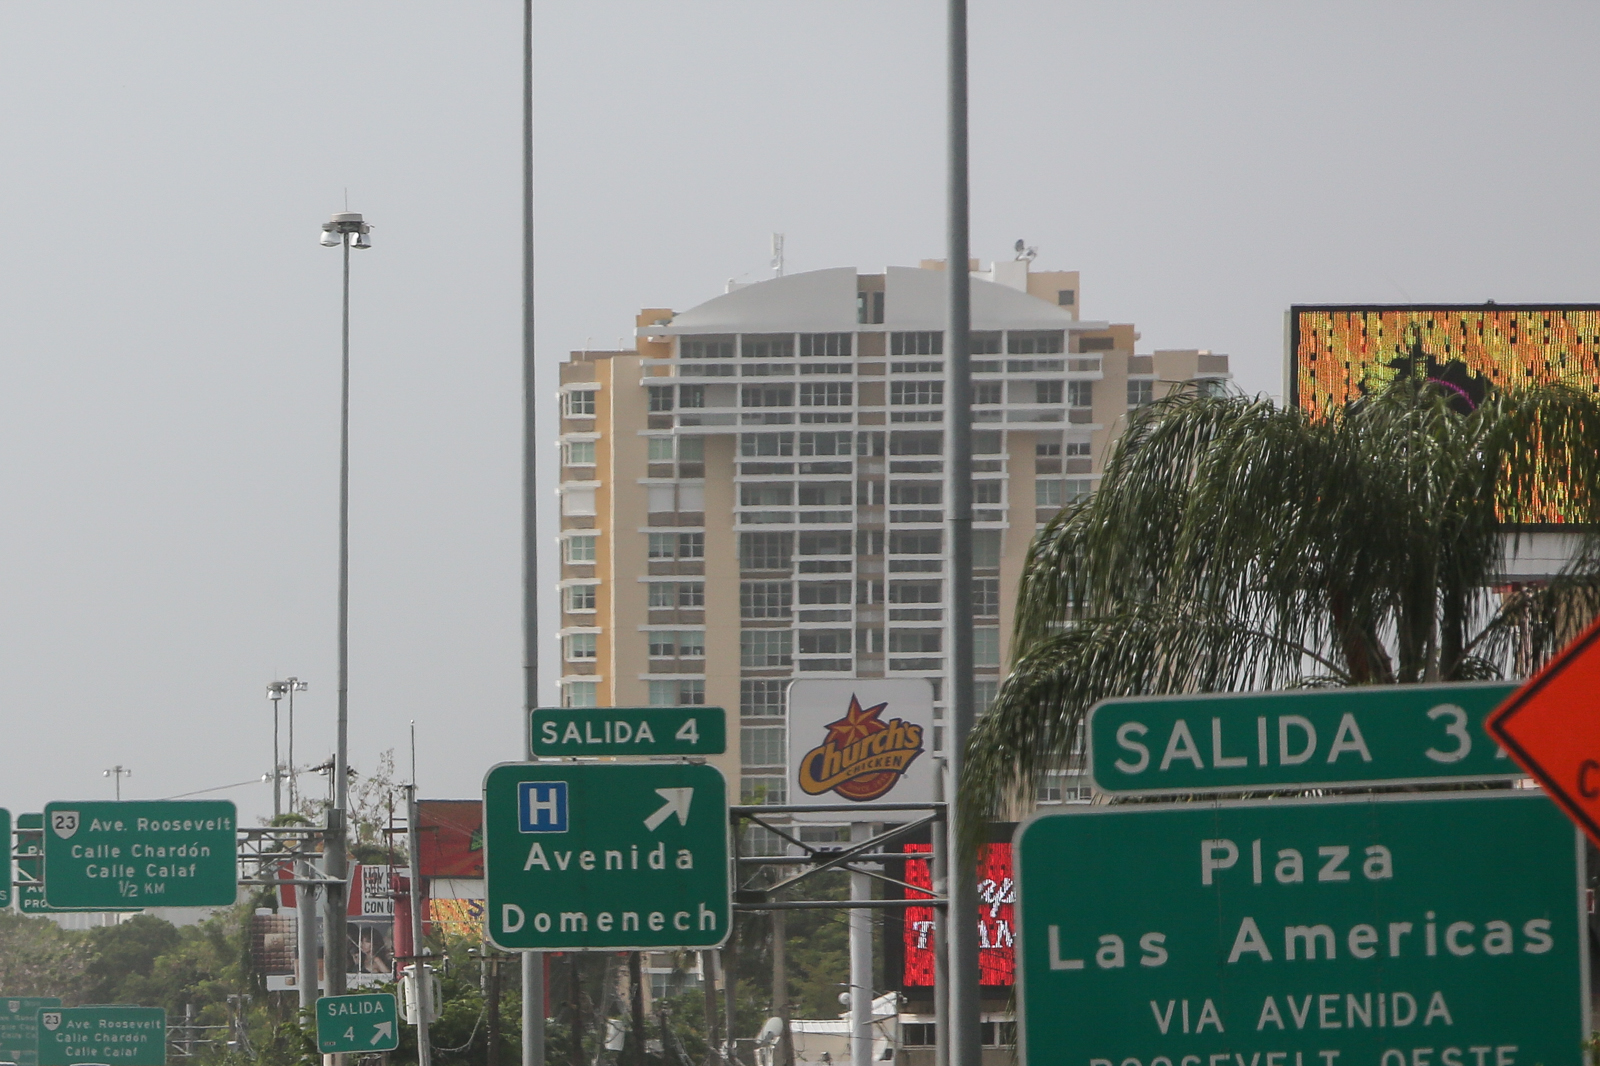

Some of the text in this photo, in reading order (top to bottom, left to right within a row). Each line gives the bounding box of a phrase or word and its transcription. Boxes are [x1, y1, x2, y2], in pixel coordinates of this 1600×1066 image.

[541, 718, 700, 744] SALIDA 4
[1114, 713, 1372, 774] SALIDA
[800, 718, 924, 795] Church's
[847, 756, 902, 775] CHICKEN
[54, 815, 231, 832] 23 Ave. Roosevelt
[71, 841, 211, 858] Calle Chardón
[523, 841, 694, 871] Avenida
[1201, 838, 1394, 885] Plaza
[86, 863, 197, 878] Calle Calaf
[144, 882, 166, 894] KM
[364, 901, 384, 914] CON
[502, 902, 717, 933] Domenech
[1048, 924, 1169, 970] Las
[1228, 911, 1554, 963] Americas
[328, 1001, 384, 1016] SALIDA
[1150, 991, 1453, 1035] VIA AVENIDA
[45, 1015, 59, 1025] 23
[99, 1019, 161, 1029] Roosevelt
[55, 1031, 147, 1042] Calle Chardón
[343, 1026, 355, 1041] 4
[65, 1046, 138, 1057] Calle Calaf
